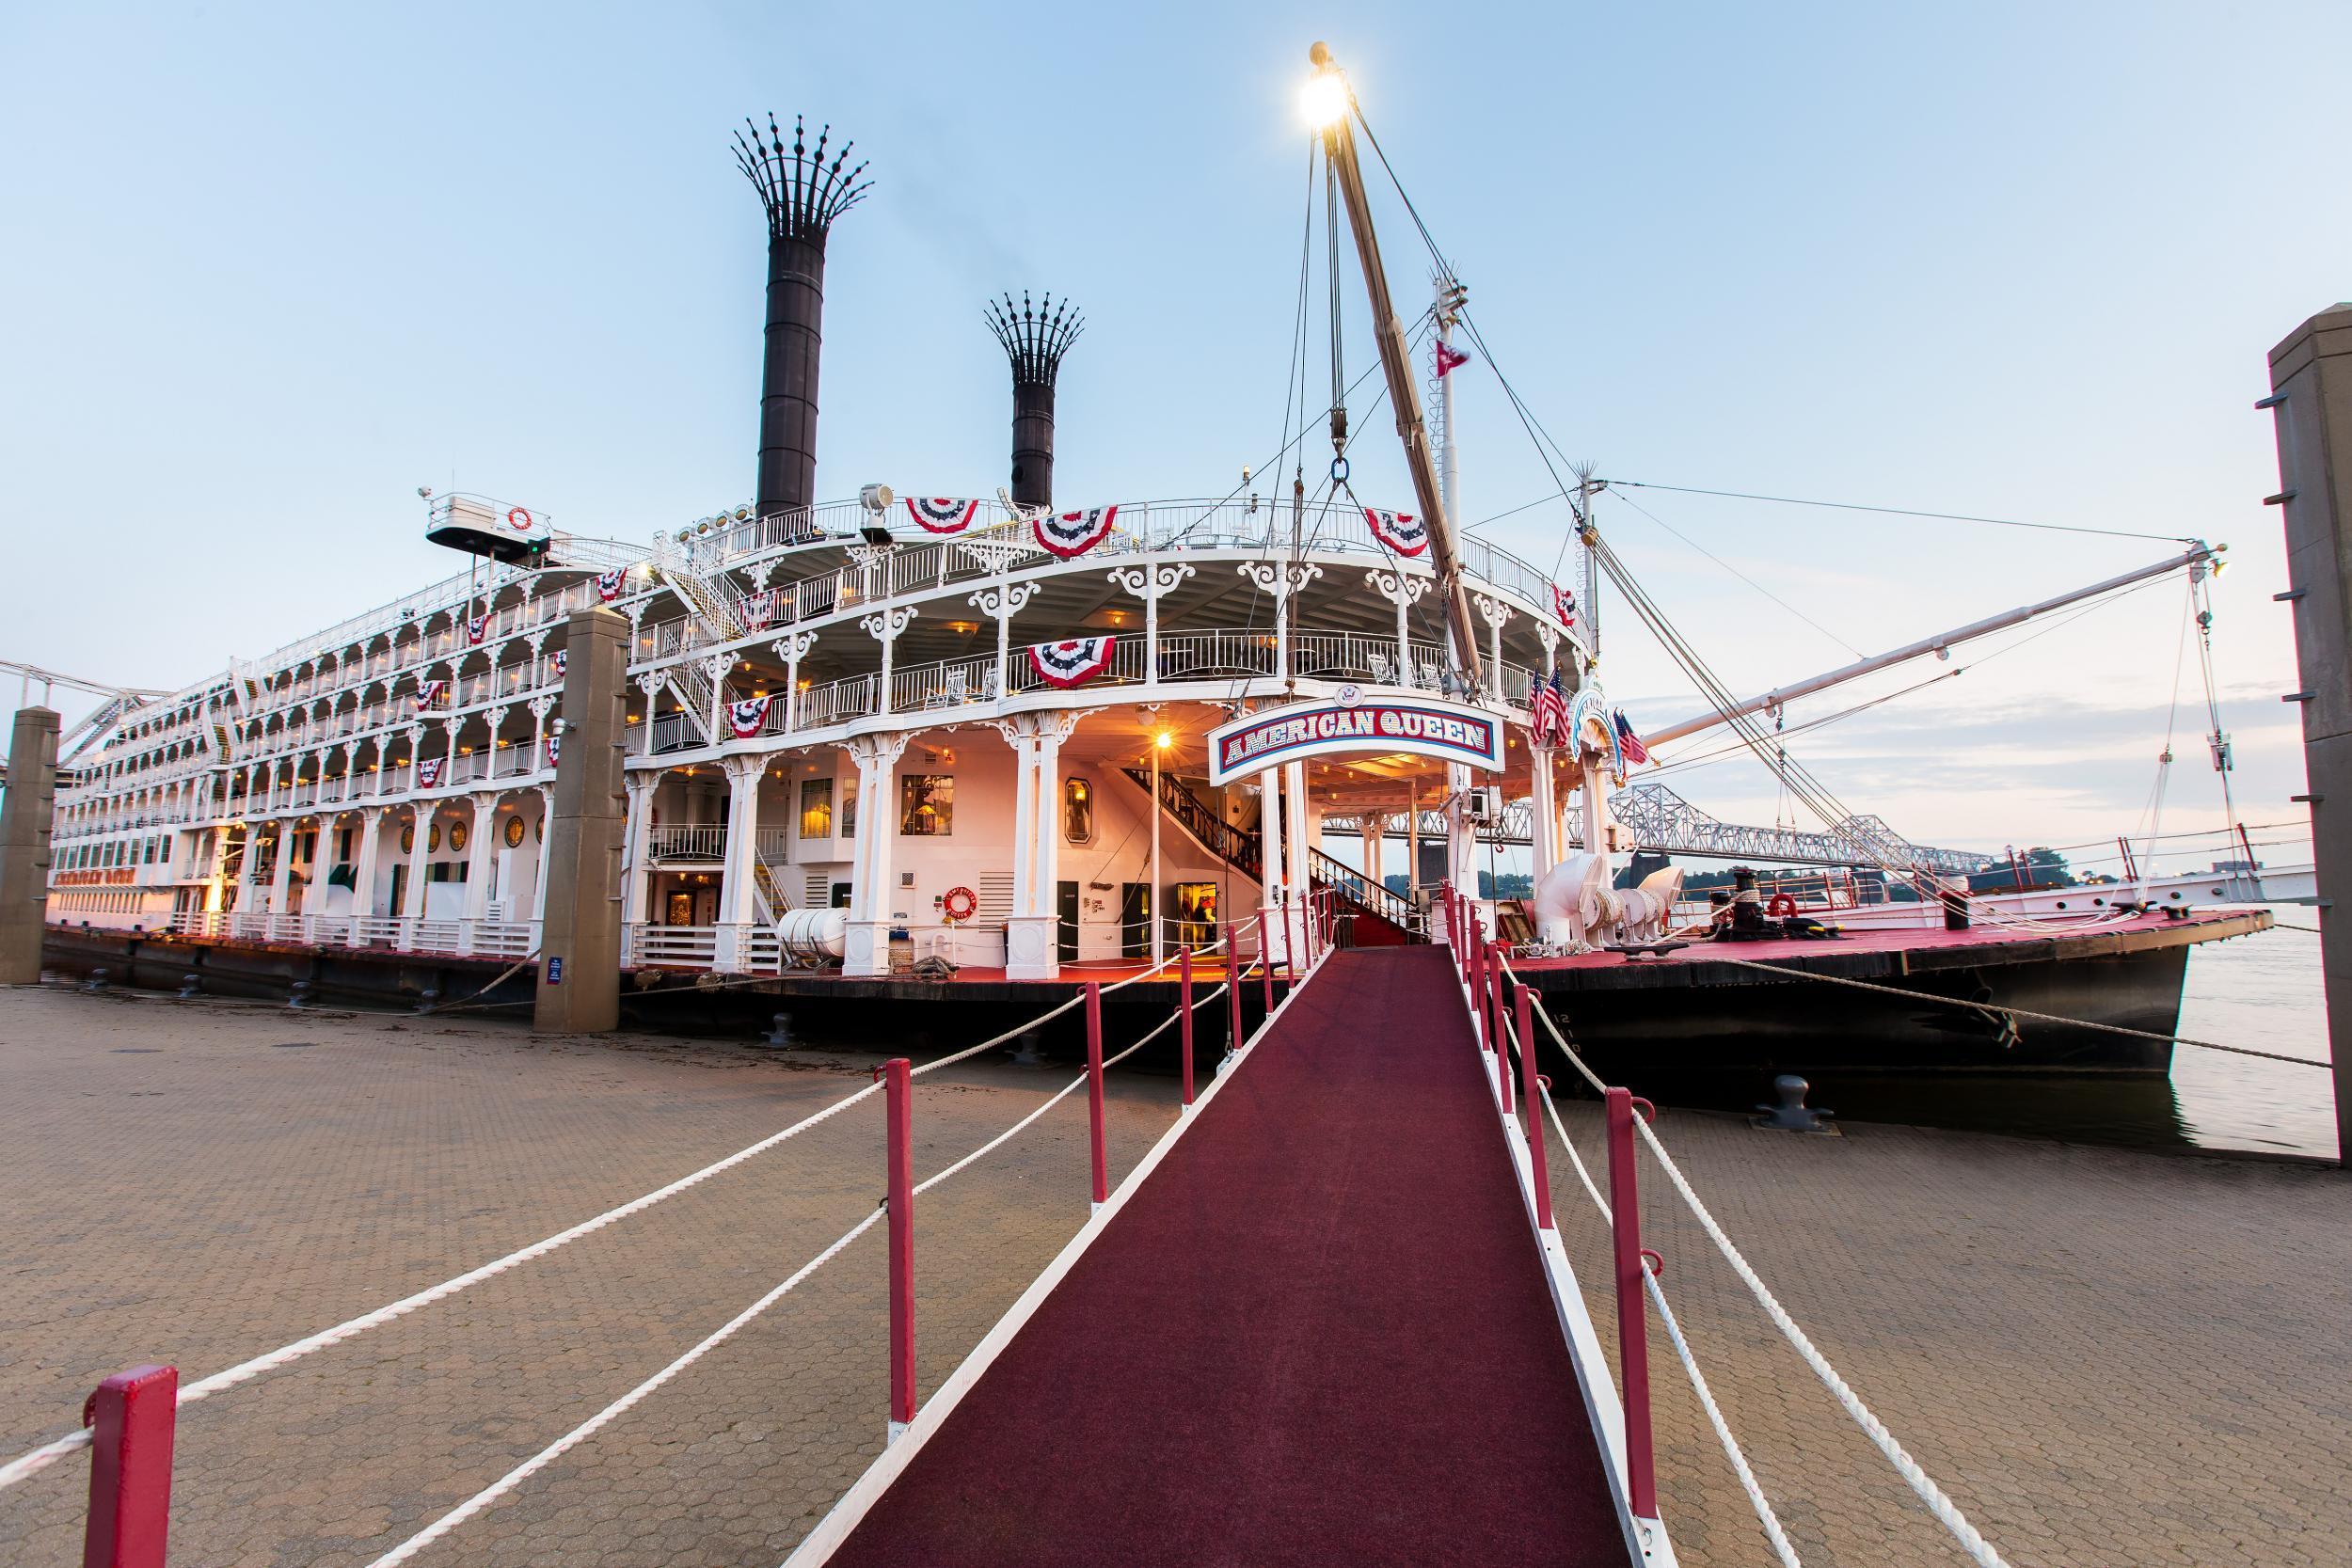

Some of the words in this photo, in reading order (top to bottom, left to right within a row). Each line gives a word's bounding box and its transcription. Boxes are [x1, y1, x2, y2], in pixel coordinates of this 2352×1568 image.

[1226, 711, 1375, 765] AMERICAN
[1380, 711, 1485, 751] QUEEN
[1553, 1013, 1571, 1023] 12
